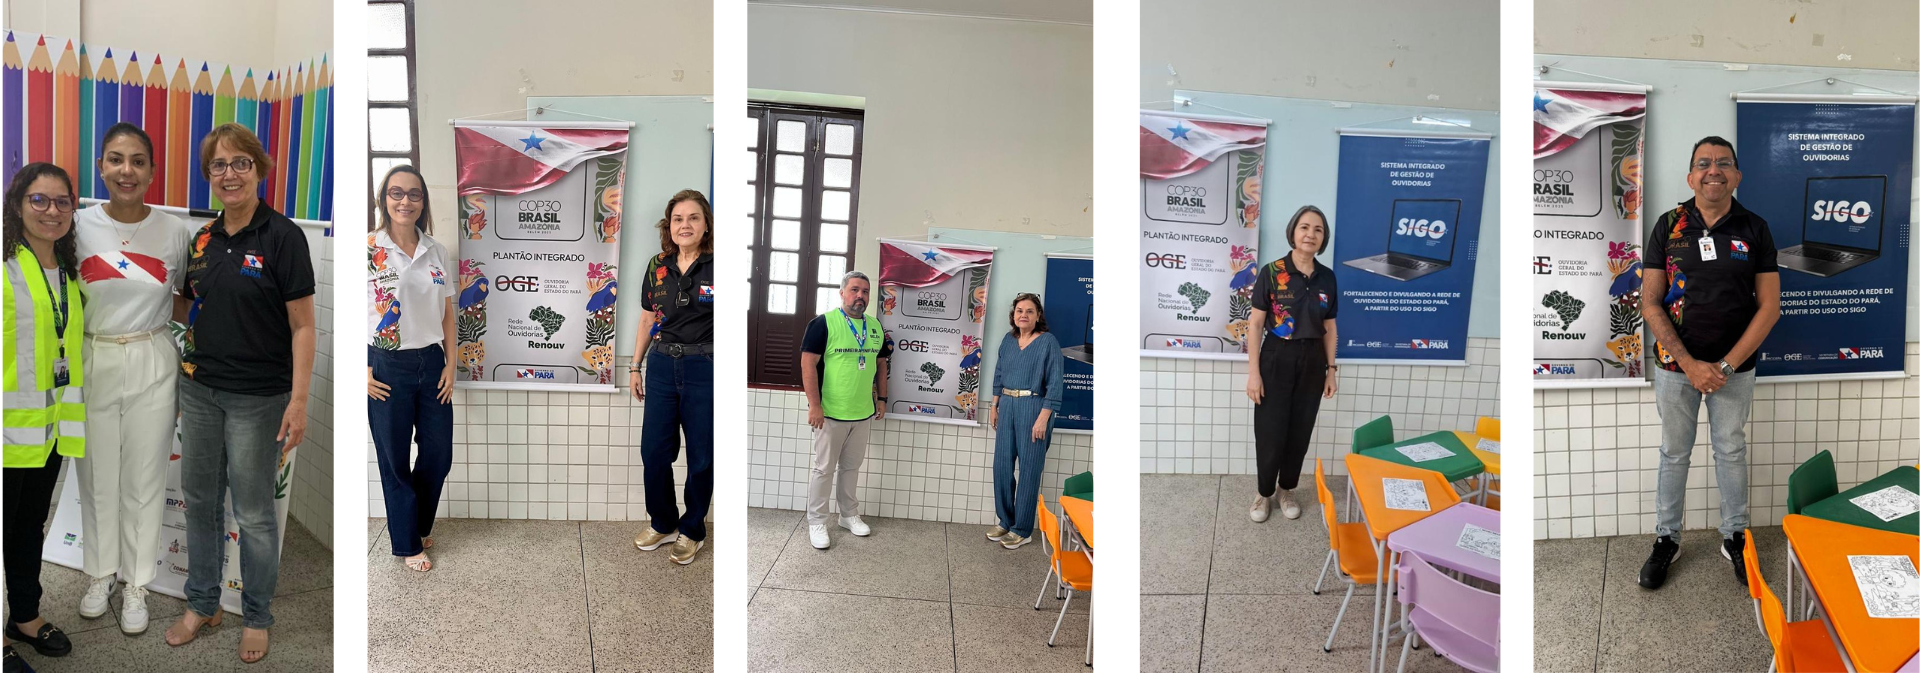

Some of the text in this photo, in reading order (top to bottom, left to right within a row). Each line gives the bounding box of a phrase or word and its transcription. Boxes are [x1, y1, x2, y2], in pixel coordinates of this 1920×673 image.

[1167, 185, 1206, 197] COP30
[519, 200, 561, 212] COP30
[1167, 196, 1206, 208] BRASIL
[519, 213, 560, 223] BRASIL
[1811, 200, 1871, 224] SIGO
[1396, 218, 1446, 239] SIGO
[1144, 231, 1228, 244] PLANTÃO INTEGRADO
[1544, 230, 1604, 240] INTEGRADO
[493, 251, 532, 260] PLANTÃO
[1146, 252, 1186, 269] OGE
[495, 275, 538, 292] OGE
[918, 292, 947, 300] COP30
[918, 299, 946, 308] BRASIL
[1177, 313, 1210, 322] Renouv
[1543, 331, 1586, 340] Renouv
[528, 341, 565, 349] Renouv
[899, 339, 928, 352] OGE
